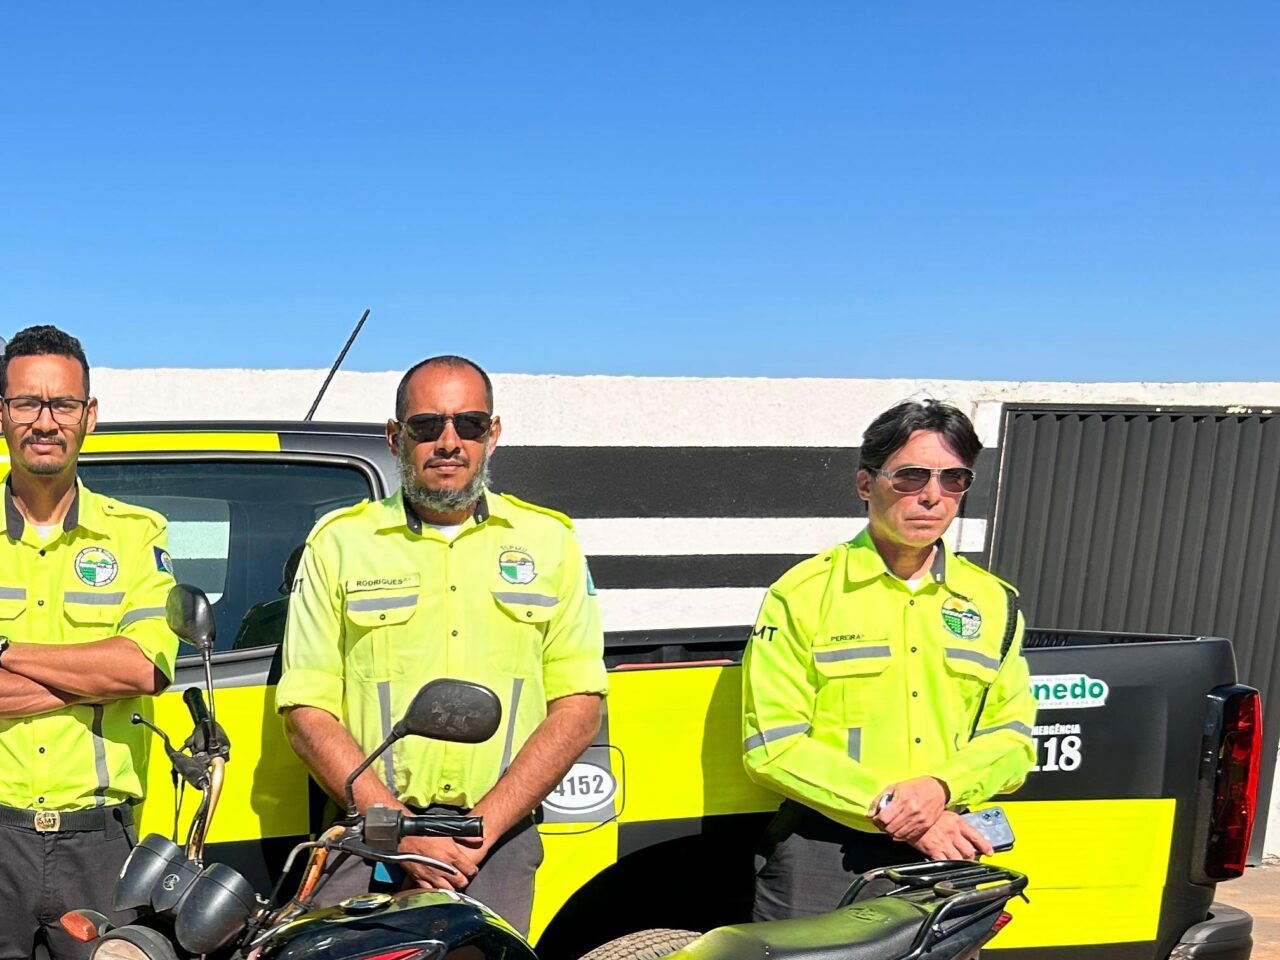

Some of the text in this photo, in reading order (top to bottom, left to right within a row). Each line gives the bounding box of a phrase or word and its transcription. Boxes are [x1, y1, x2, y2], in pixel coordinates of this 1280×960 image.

[356, 578, 403, 587] RODRIGUES
[830, 633, 861, 642] PEREIRA
[1030, 677, 1104, 700] nedo
[1031, 723, 1081, 736] MERGÊNCIA
[553, 774, 605, 797] 4152
